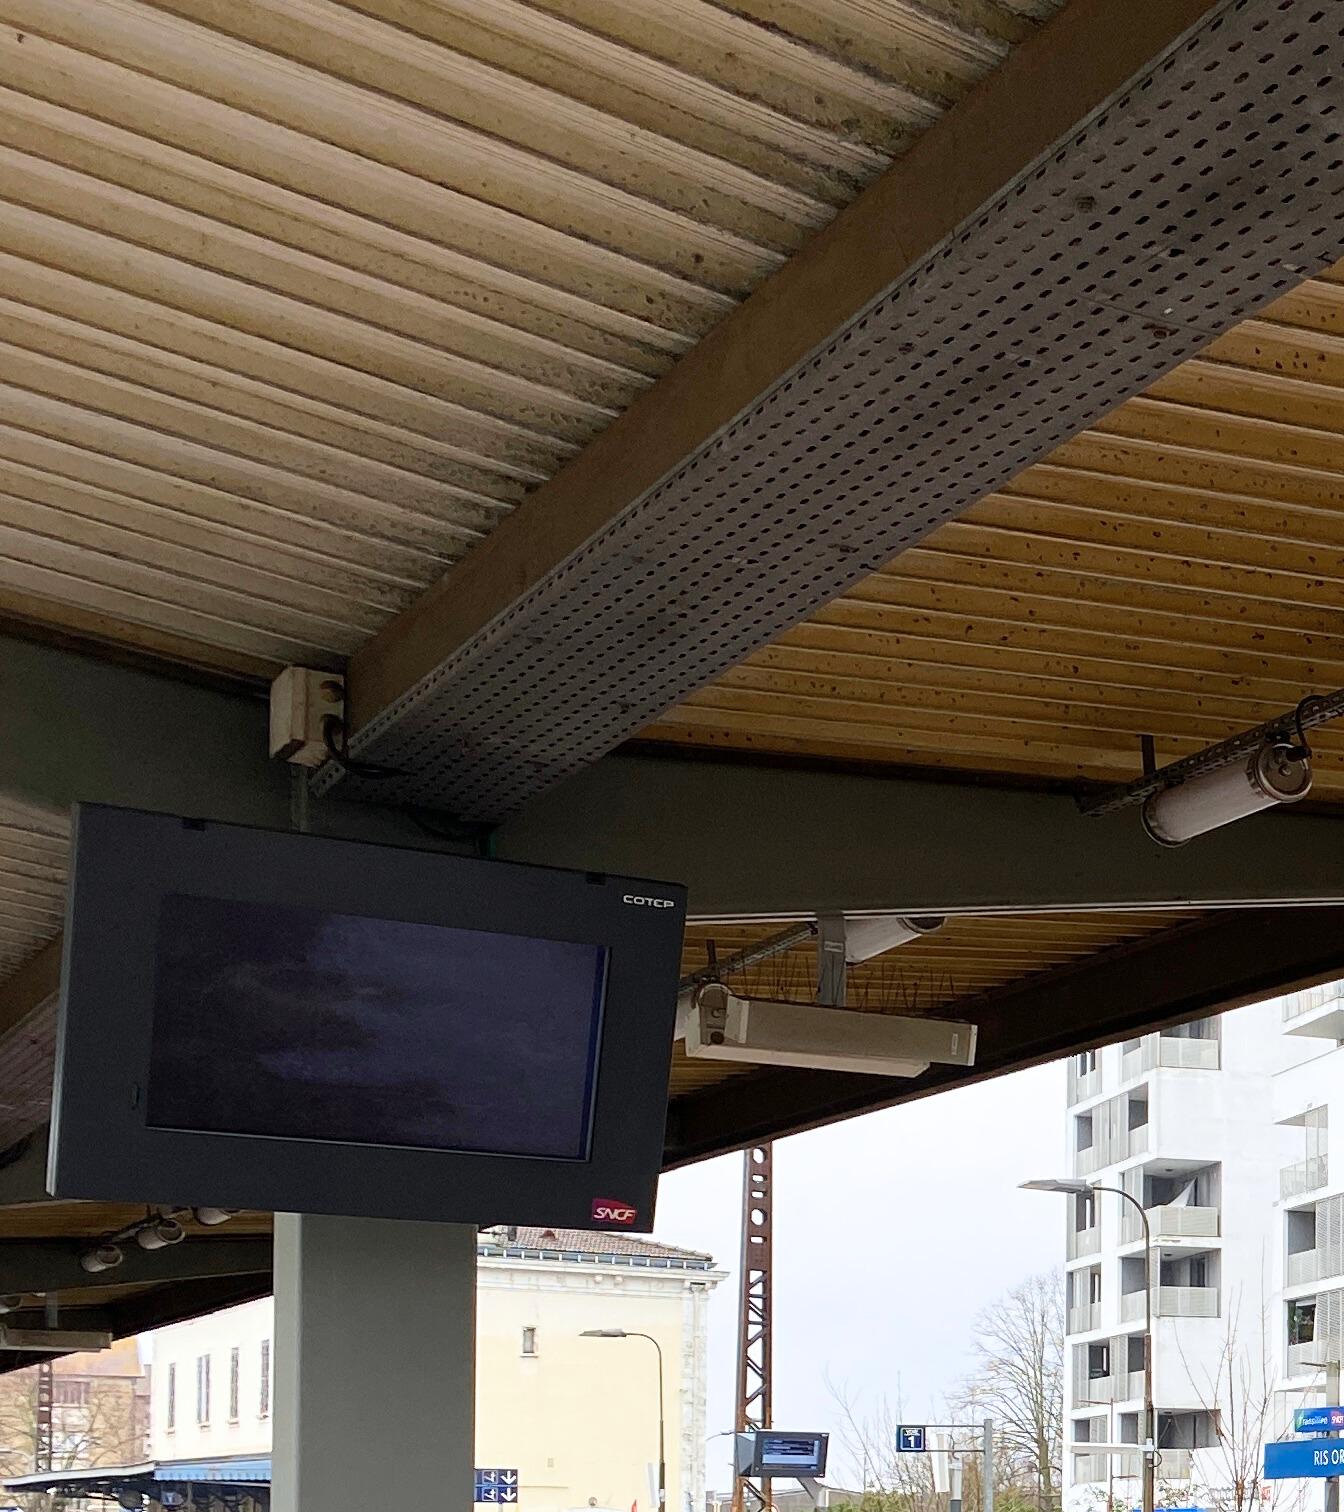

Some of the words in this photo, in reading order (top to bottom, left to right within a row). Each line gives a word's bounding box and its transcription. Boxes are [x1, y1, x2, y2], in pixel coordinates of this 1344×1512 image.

[593, 1207, 635, 1221] SNCF
[907, 1436, 915, 1448] 1
[1314, 1450, 1329, 1466] RIS
